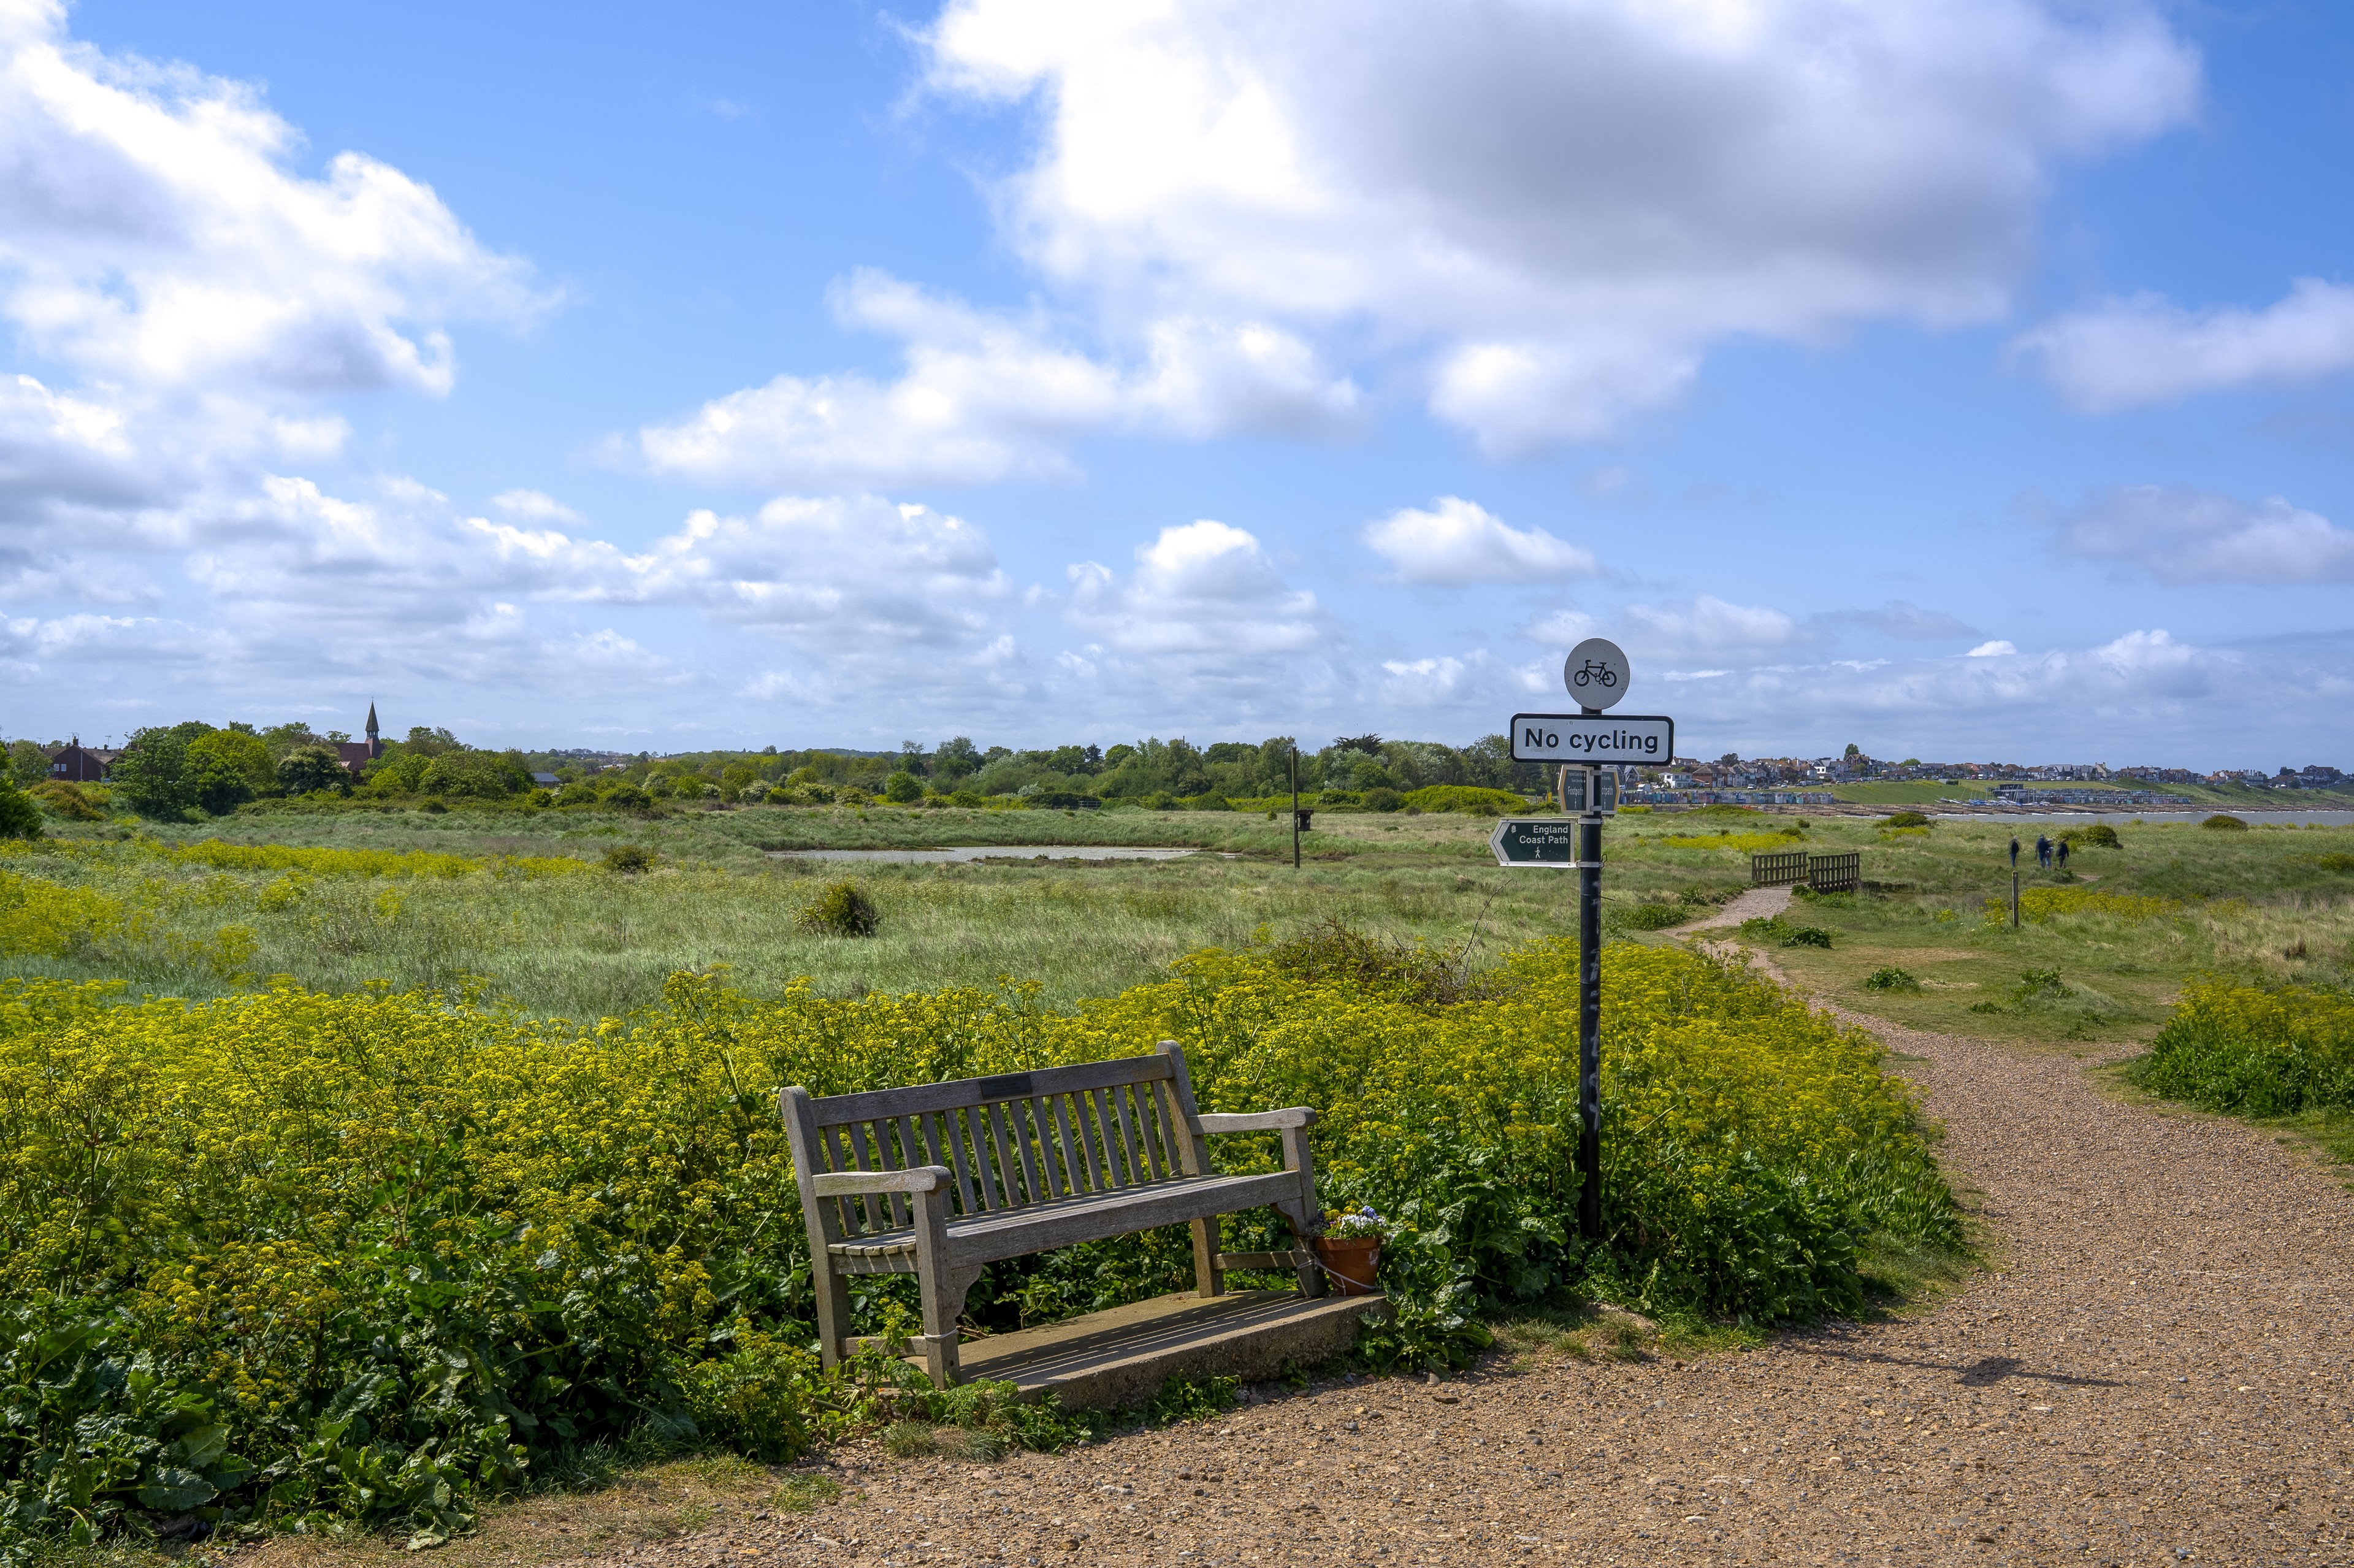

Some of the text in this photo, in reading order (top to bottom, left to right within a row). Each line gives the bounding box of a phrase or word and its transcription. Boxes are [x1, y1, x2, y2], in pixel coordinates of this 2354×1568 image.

[1525, 728, 1658, 754] No cycling
[1568, 786, 1583, 797] Footpath
[1602, 785, 1613, 797] otpath
[1533, 825, 1568, 835] England
[1519, 835, 1568, 844] Coast Path
